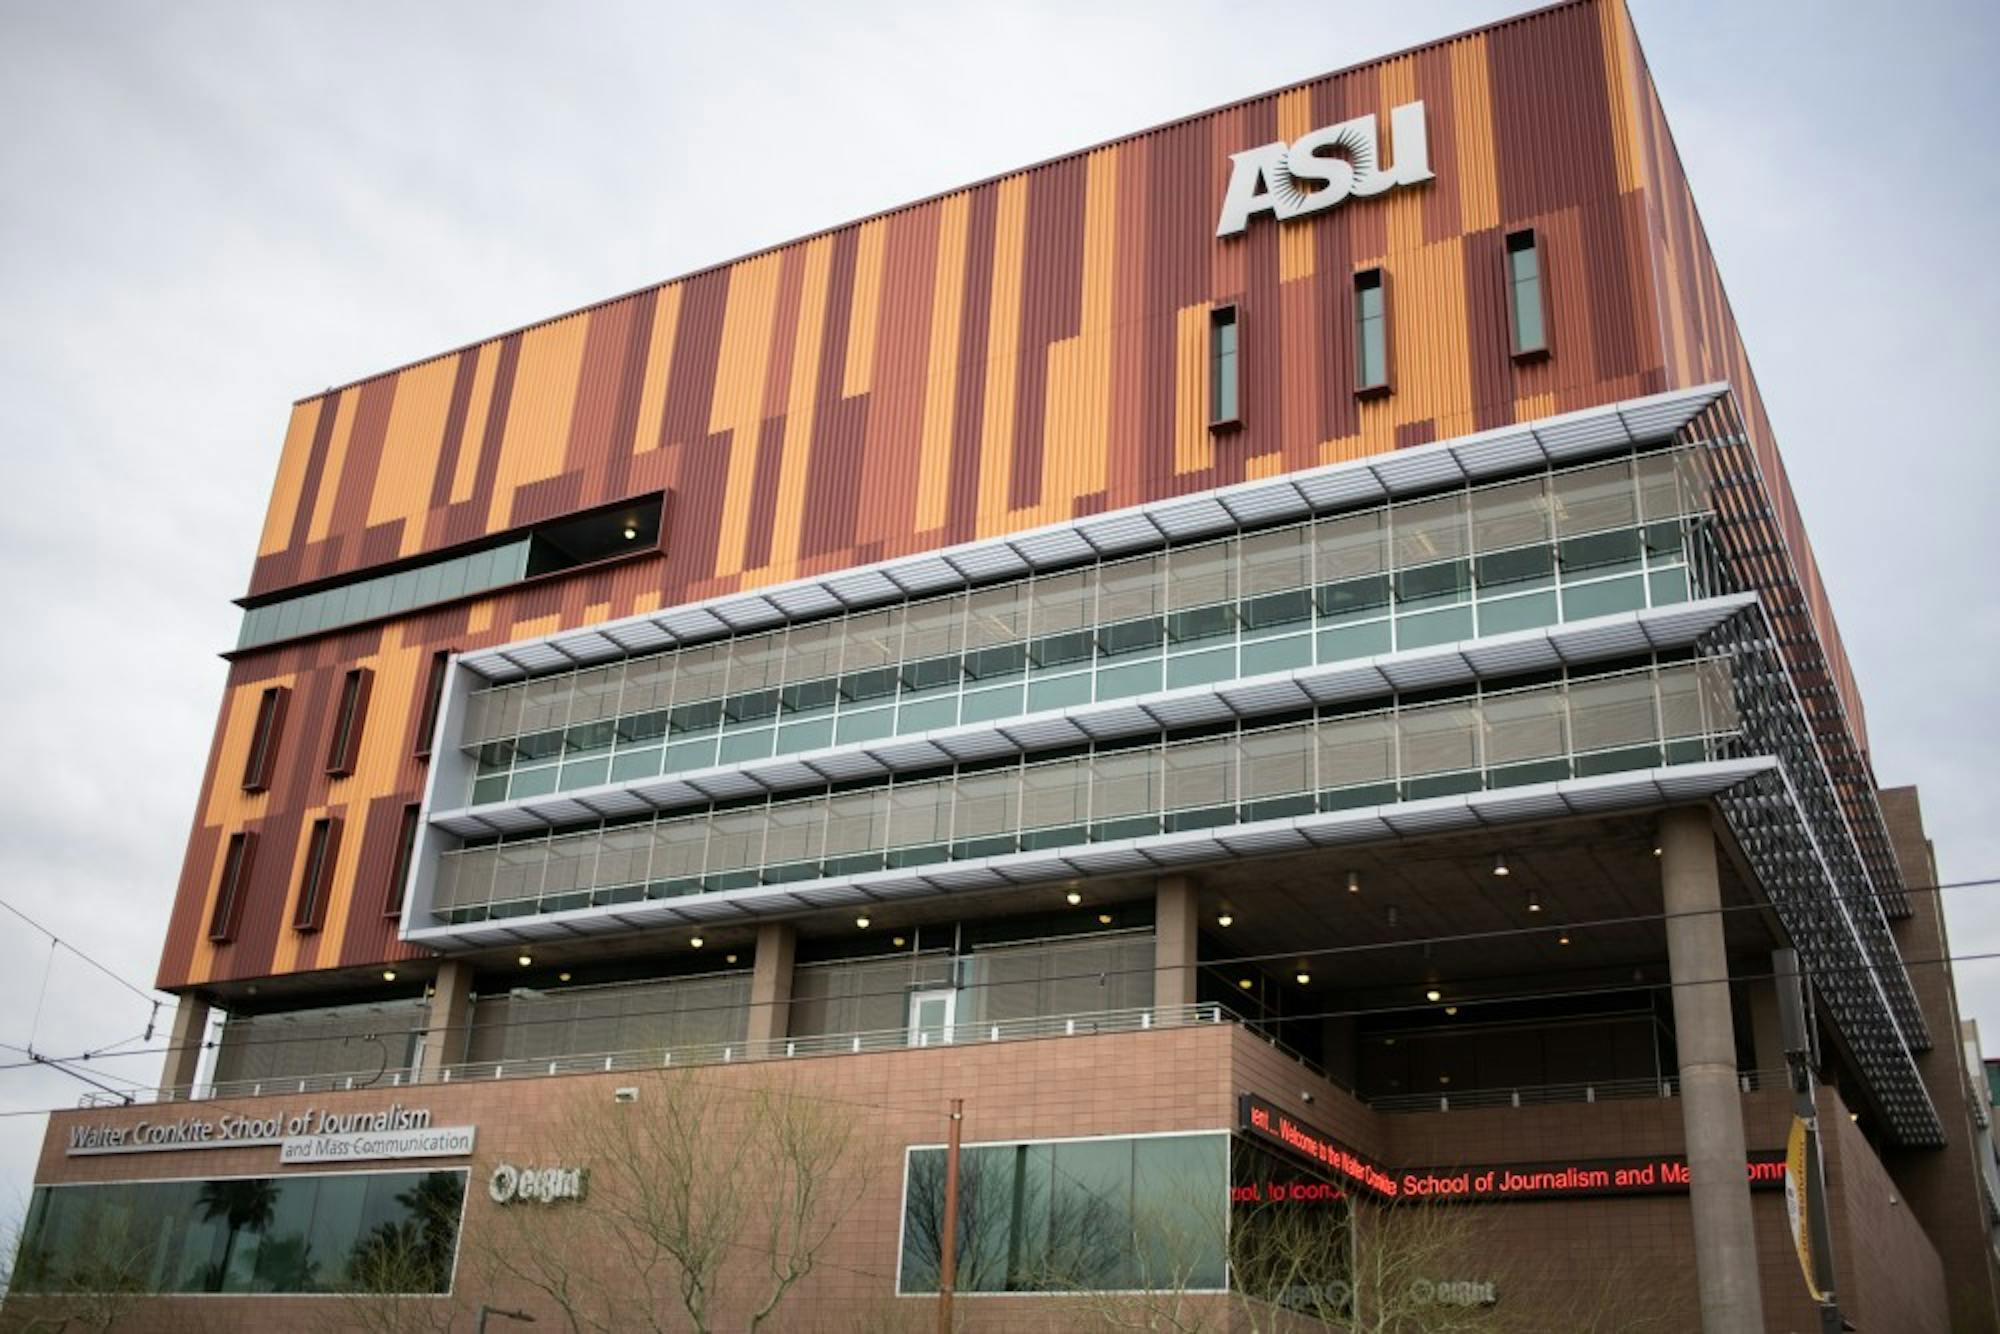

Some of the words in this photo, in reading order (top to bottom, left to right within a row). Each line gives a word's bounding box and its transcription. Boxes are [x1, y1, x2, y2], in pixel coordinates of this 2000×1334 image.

[1216, 100, 1436, 238] ASU
[70, 1121, 130, 1148] Walter
[133, 1113, 213, 1145] Cronkite
[218, 1110, 284, 1139] School
[288, 1108, 314, 1135] of
[313, 1104, 431, 1134] Journalism
[285, 1141, 313, 1157] and
[315, 1138, 350, 1155] Mass
[353, 1131, 469, 1154] Communication
[1403, 1174, 1469, 1196] School
[1475, 1171, 1495, 1192] of
[1499, 1167, 1609, 1191] Journalism
[1615, 1164, 1654, 1186] and
[1661, 1162, 1691, 1184] Ma
